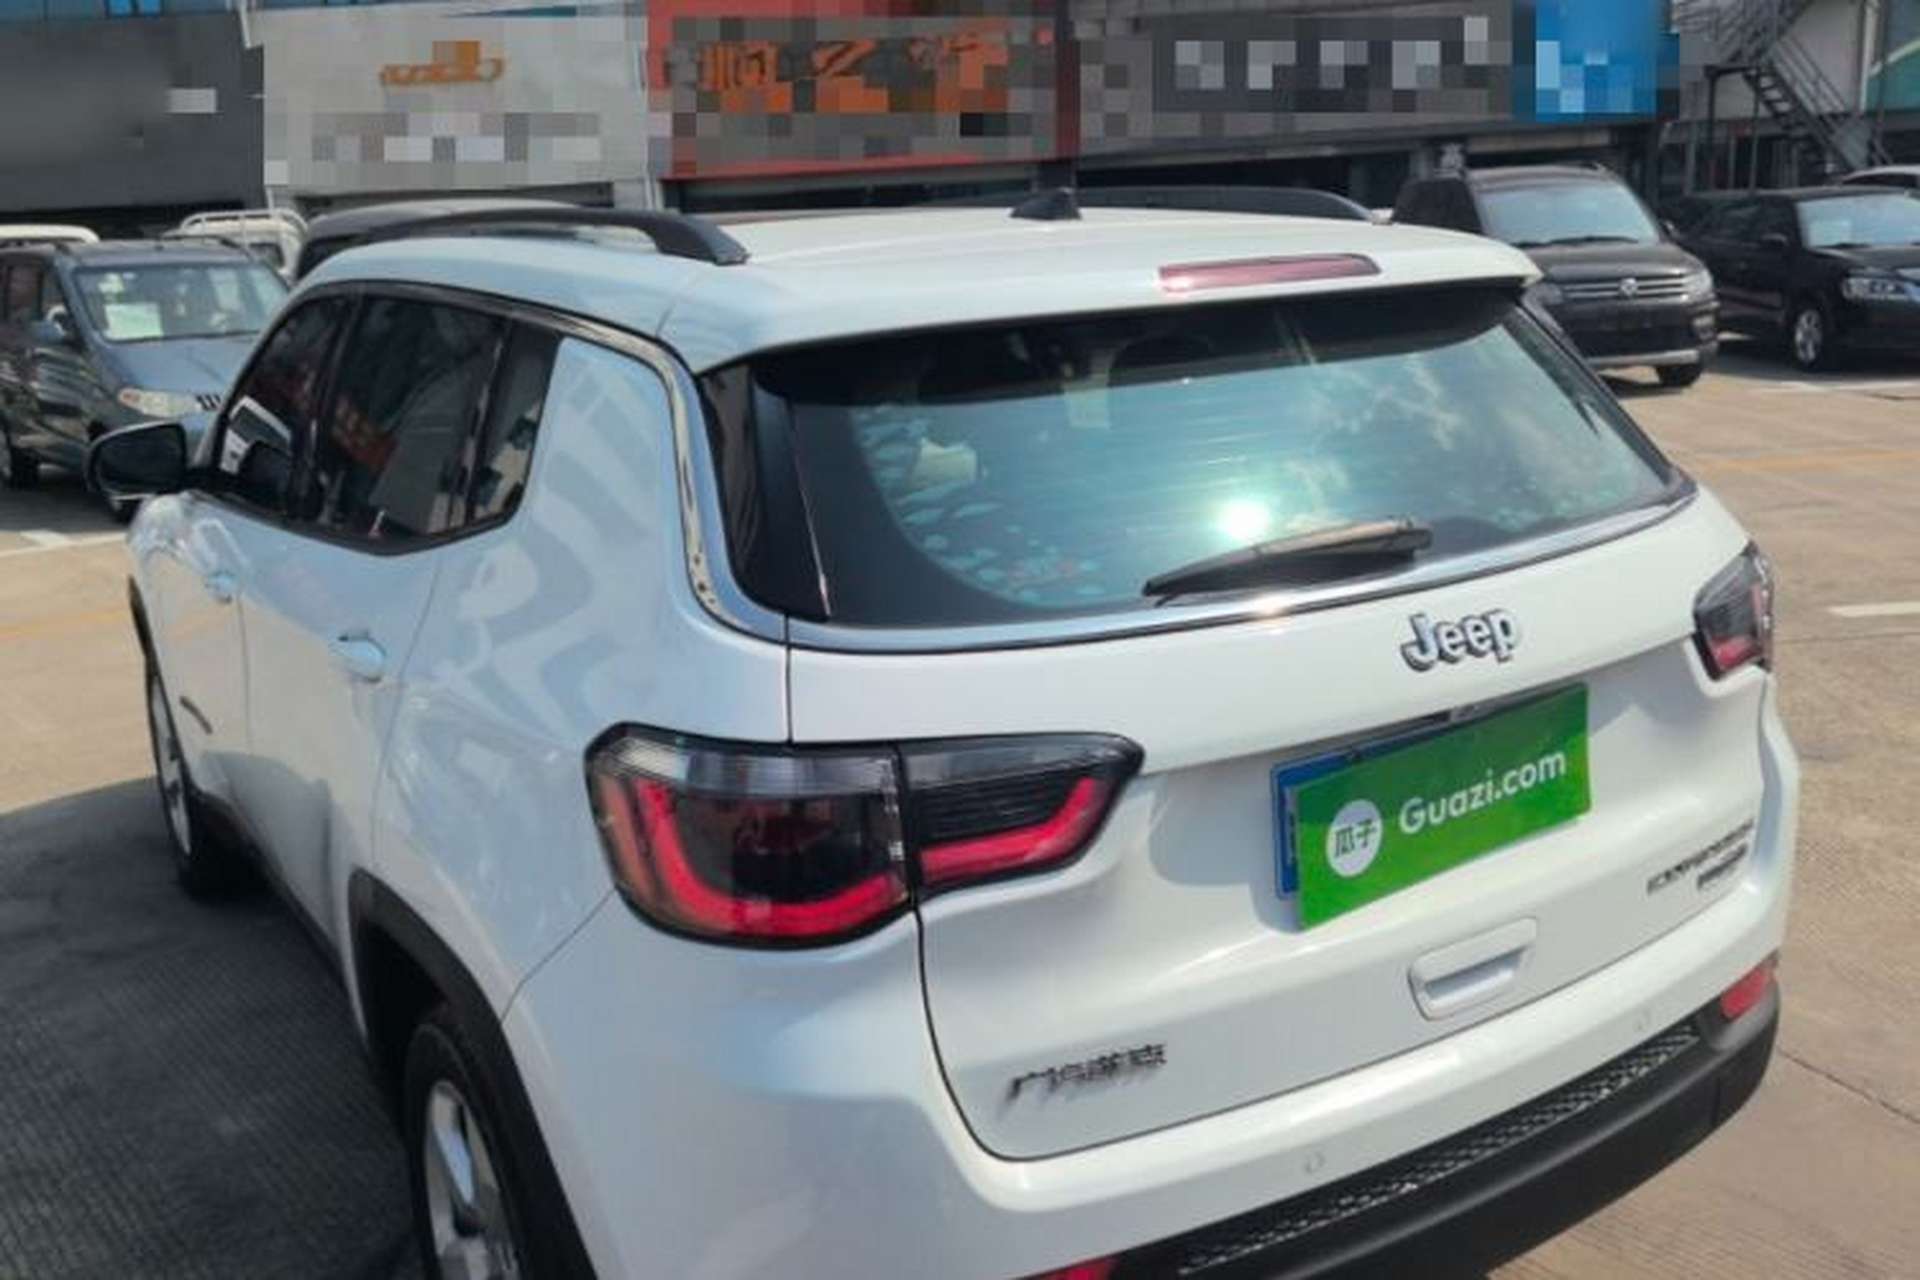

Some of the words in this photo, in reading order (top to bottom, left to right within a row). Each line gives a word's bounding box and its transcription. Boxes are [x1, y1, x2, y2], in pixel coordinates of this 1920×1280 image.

[1401, 608, 1520, 672] Jeep
[1400, 752, 1567, 833] Guazi.com
[1335, 818, 1375, 858] 瓜子
